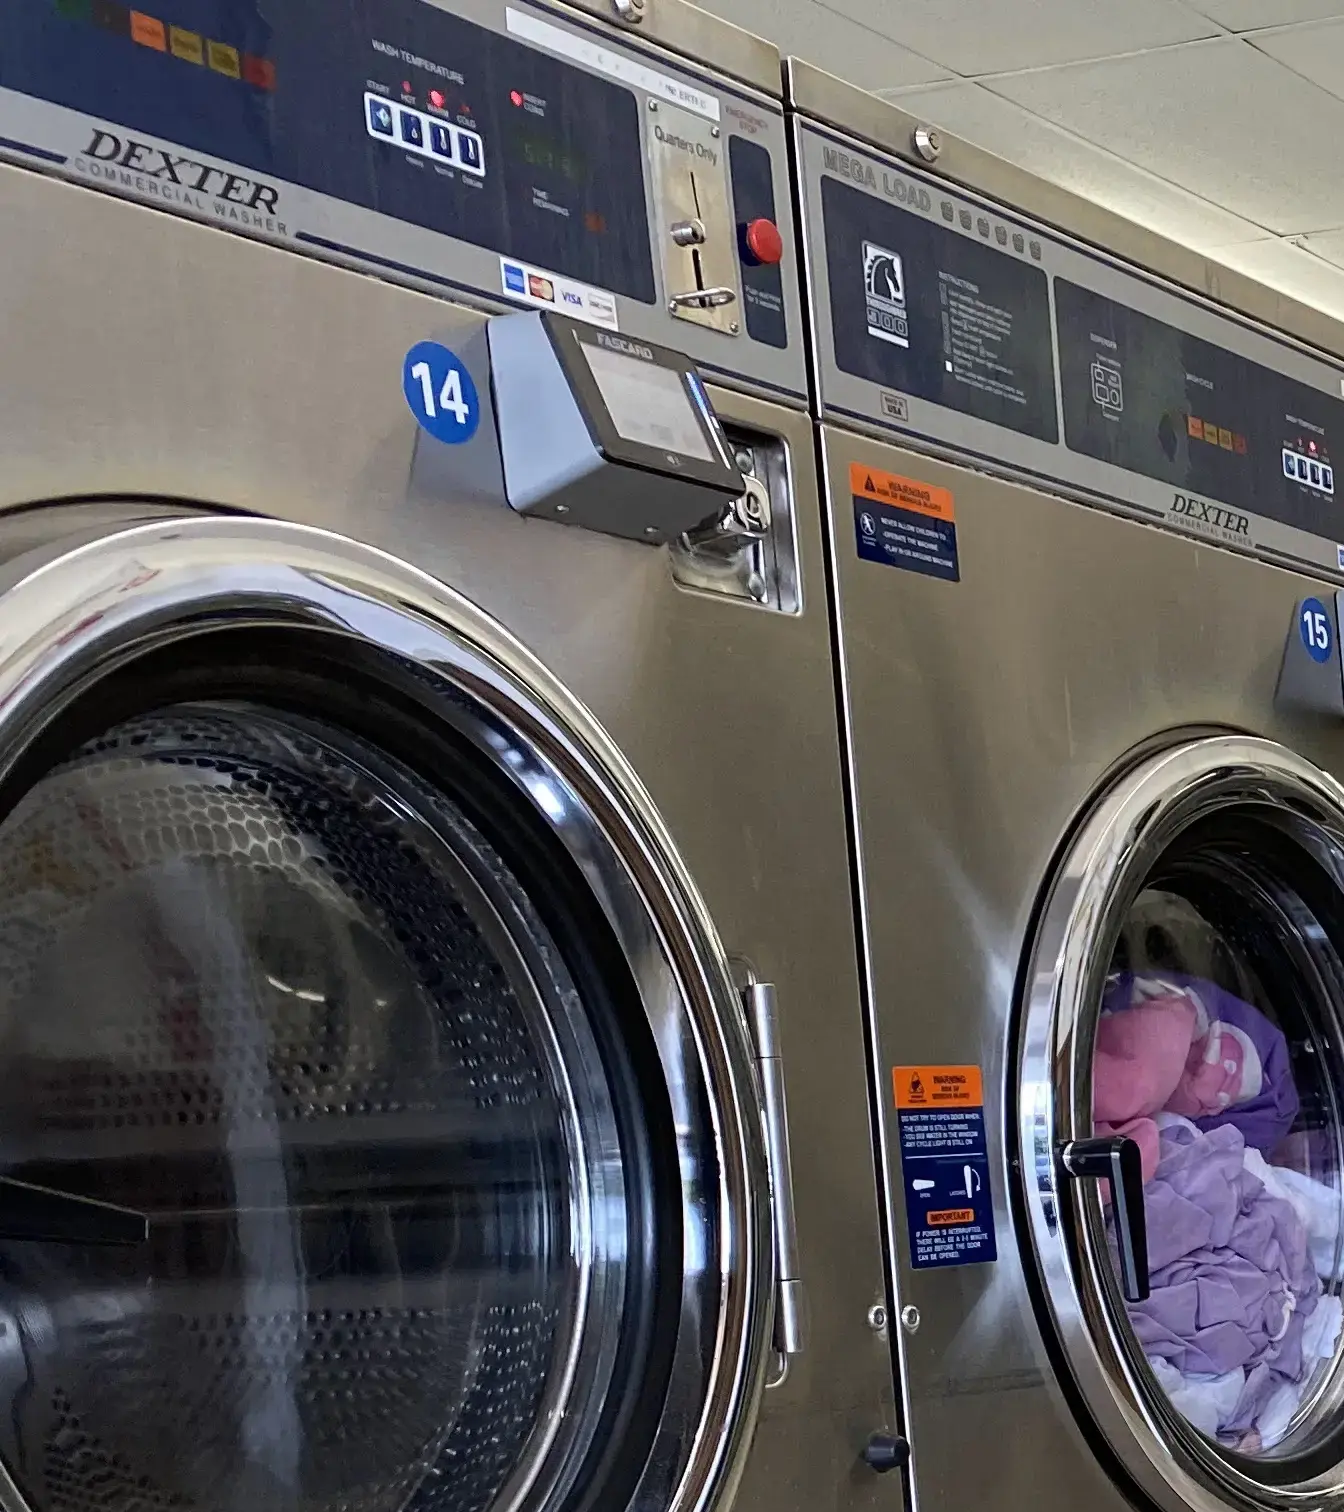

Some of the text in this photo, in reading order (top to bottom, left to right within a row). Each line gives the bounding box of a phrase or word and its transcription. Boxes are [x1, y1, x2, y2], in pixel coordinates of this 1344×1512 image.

[371, 38, 465, 85] WASH TEMPERATURE
[654, 125, 718, 166] Quarters Only
[80, 127, 280, 216] DEXTER
[822, 146, 932, 213] MEGA LOAD
[74, 157, 289, 237] COMMERCIAL WASHER
[561, 290, 583, 308] VISA
[596, 333, 653, 360] FASCARD
[411, 361, 470, 425] 14
[887, 480, 931, 501] WARNING
[1167, 513, 1220, 539] COMMERCIAL
[1169, 493, 1250, 536] DEXTER
[1303, 610, 1329, 650] 15
[930, 1211, 970, 1222] IMPORTANT
[917, 1246, 933, 1254] DELAY
[934, 1244, 954, 1252] BEFORE
